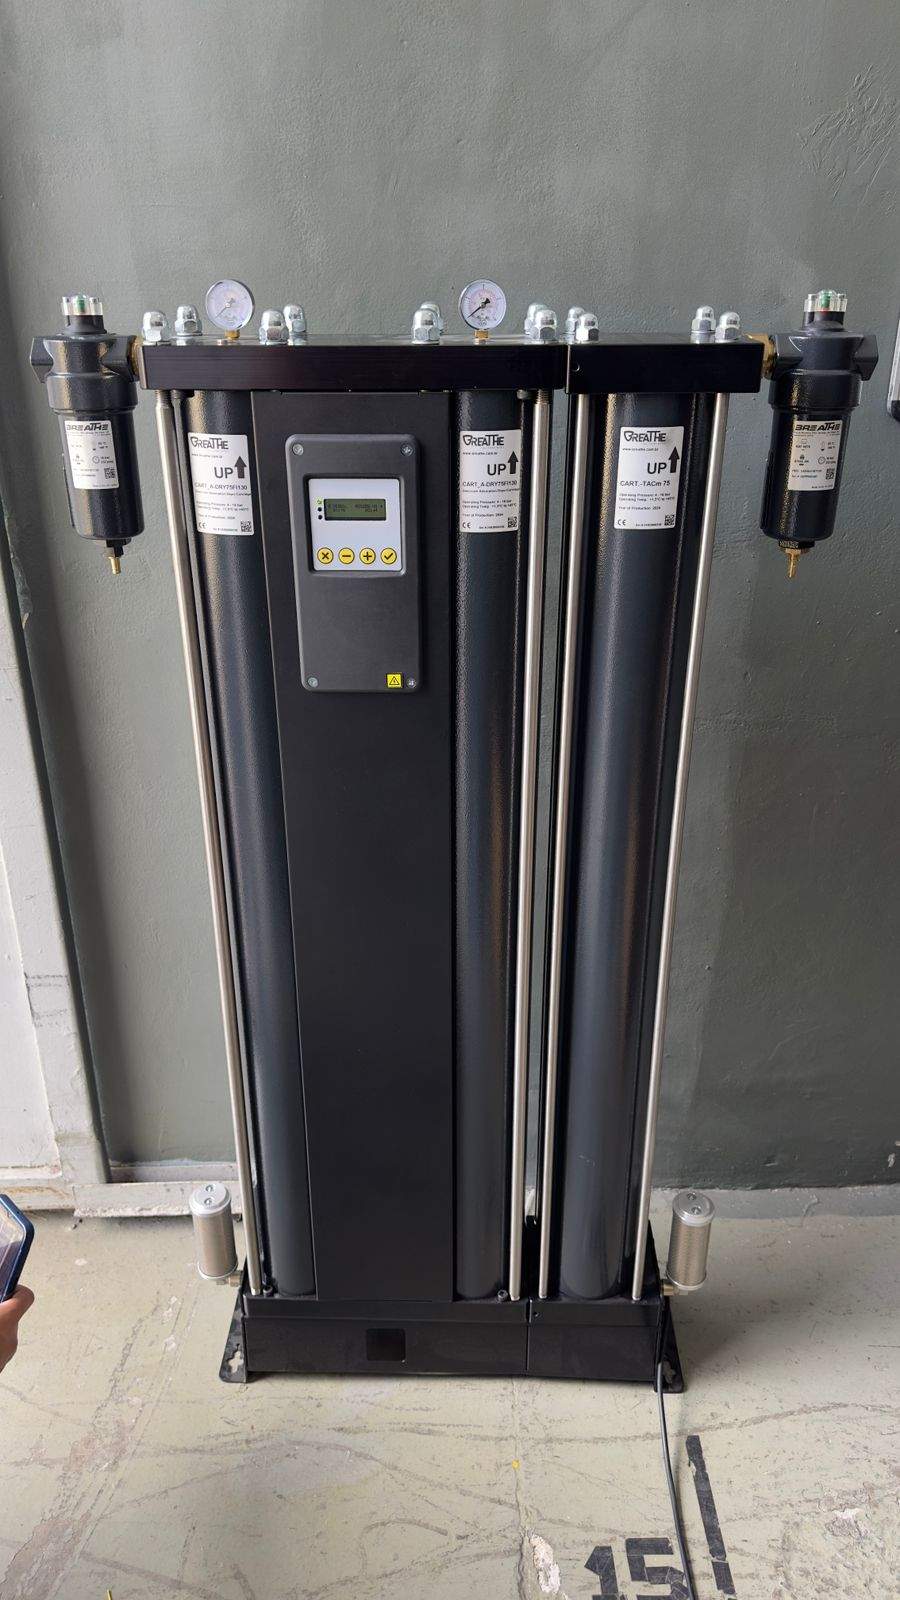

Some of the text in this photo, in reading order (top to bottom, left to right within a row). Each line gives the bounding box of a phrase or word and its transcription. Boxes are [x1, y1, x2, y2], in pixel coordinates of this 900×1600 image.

[67, 422, 108, 431] BREATHE
[795, 422, 840, 431] BREATHE
[463, 434, 504, 446] BREATHE
[624, 431, 666, 442] BREATHE
[190, 436, 229, 449] BREATHE
[214, 467, 233, 478] UP
[487, 464, 506, 476] UP
[647, 462, 667, 475] UP
